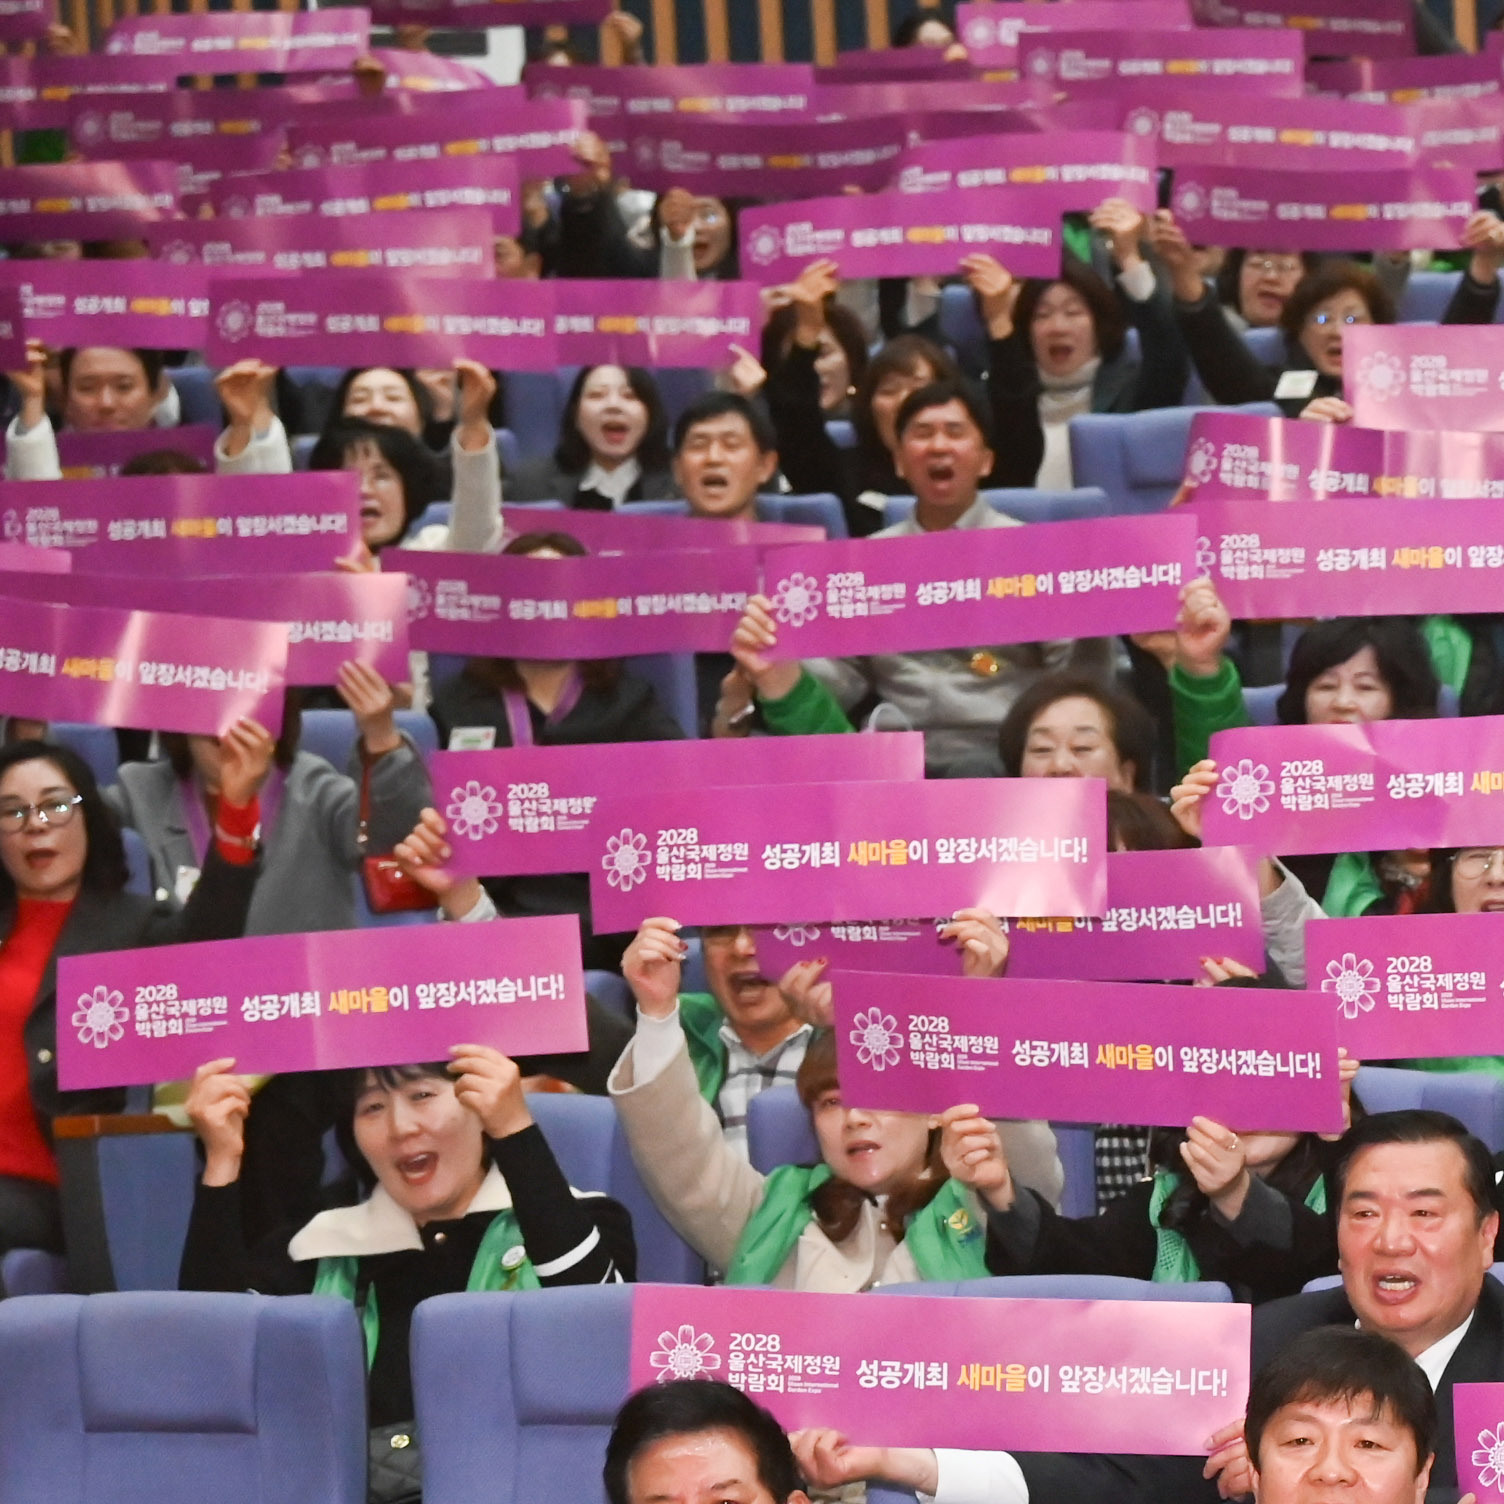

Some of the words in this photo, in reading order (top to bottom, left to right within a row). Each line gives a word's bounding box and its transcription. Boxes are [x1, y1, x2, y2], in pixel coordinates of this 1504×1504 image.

[1386, 771, 1463, 799] 성공개최
[761, 841, 840, 870] 성공개최
[847, 838, 928, 867] 새마을이
[936, 836, 1088, 864] 앞장서겠습니다!
[1387, 955, 1432, 973] 2028
[135, 983, 177, 1001] 2028
[240, 990, 320, 1022] 성공개최
[328, 984, 409, 1016] 새마을이
[416, 973, 564, 1009] 앞장서겠습니다!
[908, 1014, 950, 1033] 2028
[1011, 1040, 1089, 1068] 성공개최
[1095, 1042, 1173, 1072] 새마을이
[1179, 1046, 1321, 1078] 앞장서겠습니다!
[729, 1333, 781, 1352] 2028
[728, 1352, 840, 1375] 울산국제정원
[728, 1373, 784, 1393] 박람회
[855, 1360, 948, 1390] 성공개최
[957, 1363, 1049, 1393] 새마을이
[1059, 1364, 1227, 1396] 앞장서겠습니다!
